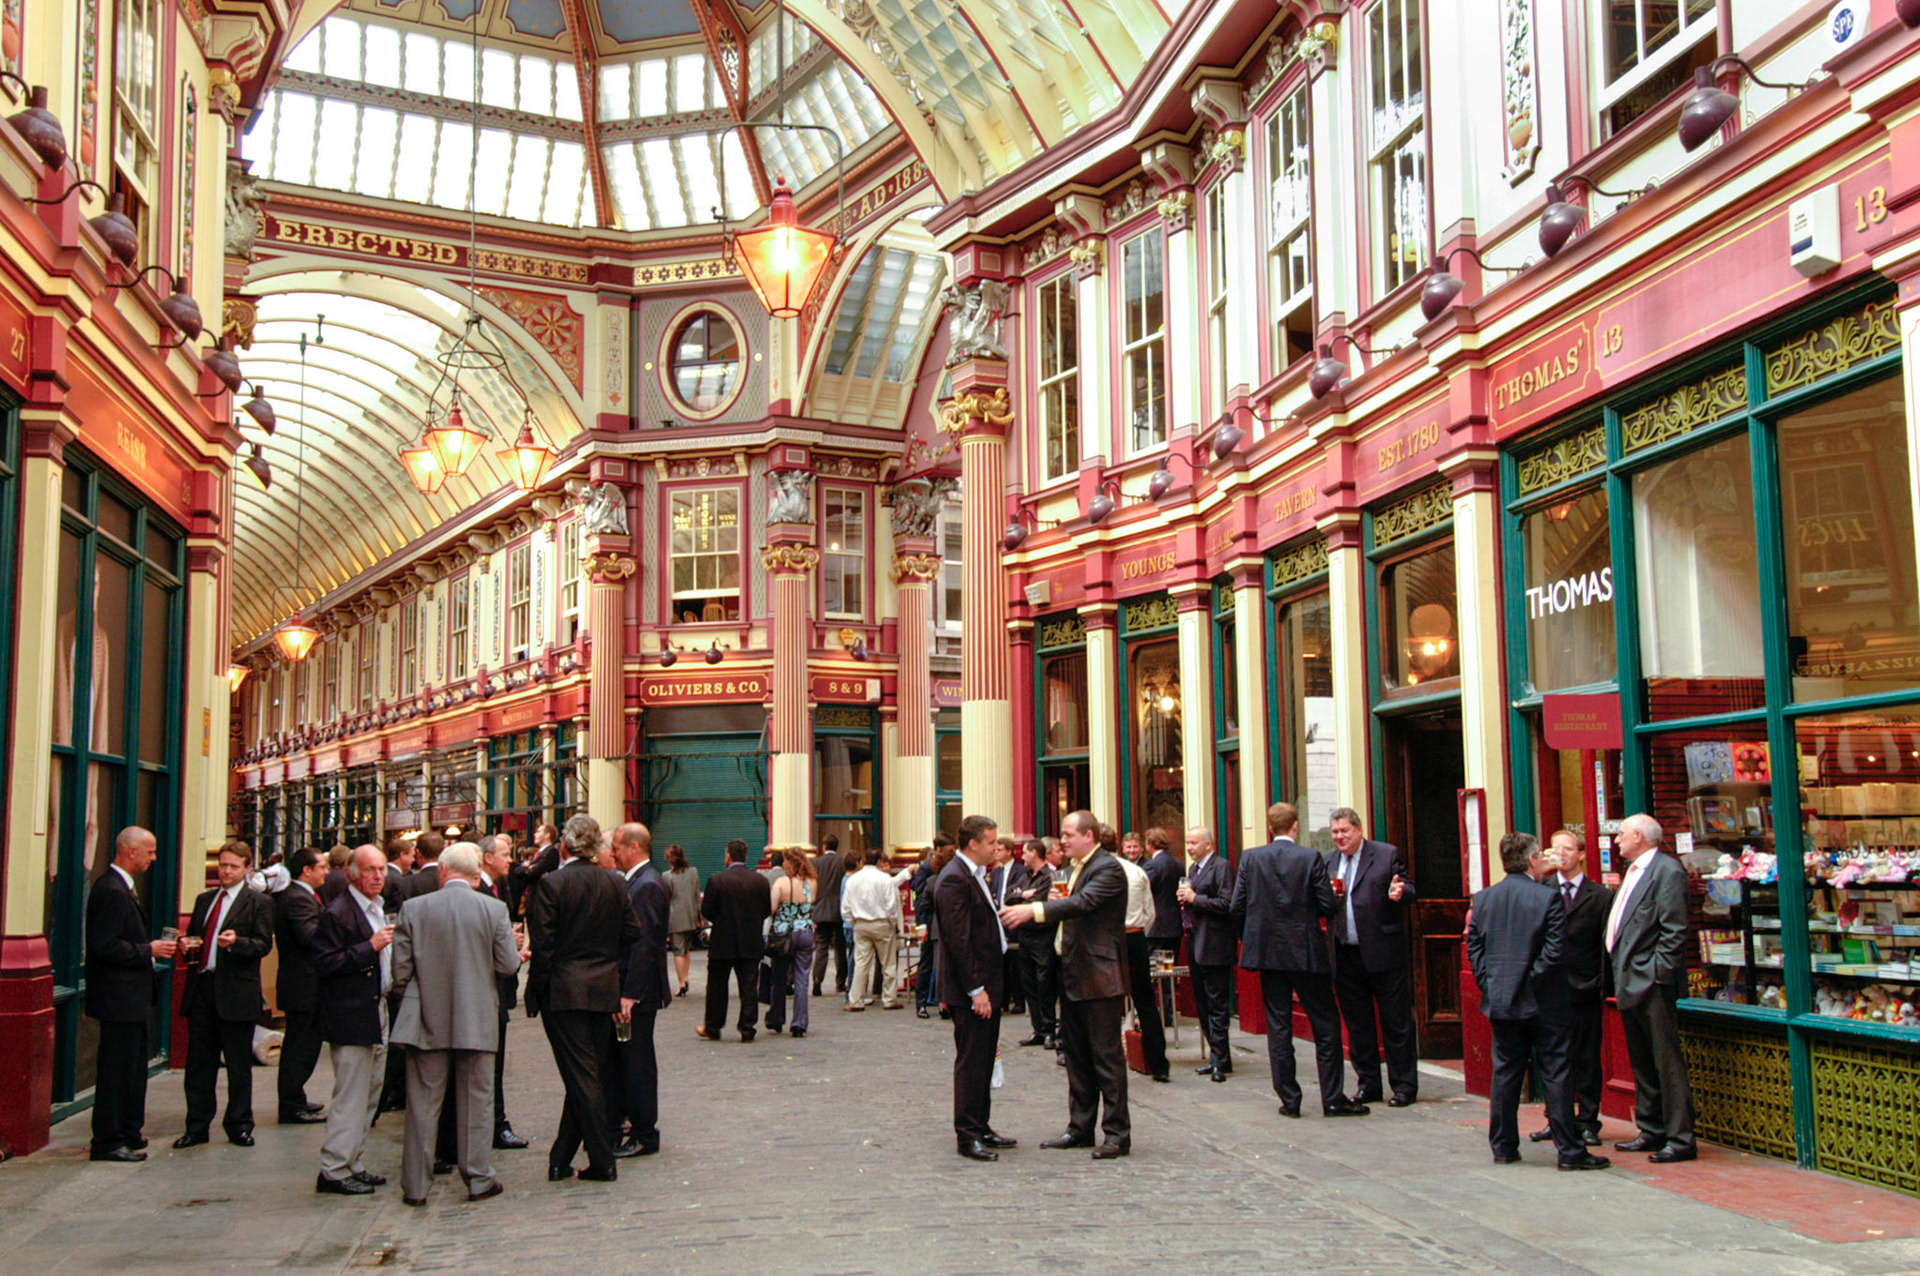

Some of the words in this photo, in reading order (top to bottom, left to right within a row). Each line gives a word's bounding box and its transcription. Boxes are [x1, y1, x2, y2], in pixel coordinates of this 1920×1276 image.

[895, 160, 928, 196] 188
[1854, 186, 1888, 233] 13
[275, 219, 458, 265] ERECTED
[11, 327, 25, 363] 27
[1495, 339, 1584, 411] THOMAS'
[1602, 324, 1623, 357] 13
[117, 421, 147, 469] REISS
[1378, 439, 1406, 472] EST.
[1408, 421, 1439, 457] 1780
[1274, 484, 1317, 523] TAVERN
[1122, 552, 1176, 580] YOUNGS
[1525, 567, 1613, 619] THOMAS
[648, 683, 723, 697] OLIVIERS
[726, 682, 736, 694] &
[739, 681, 761, 694] CO.
[829, 682, 838, 693] 8
[841, 682, 851, 694] &
[854, 683, 863, 694] 9
